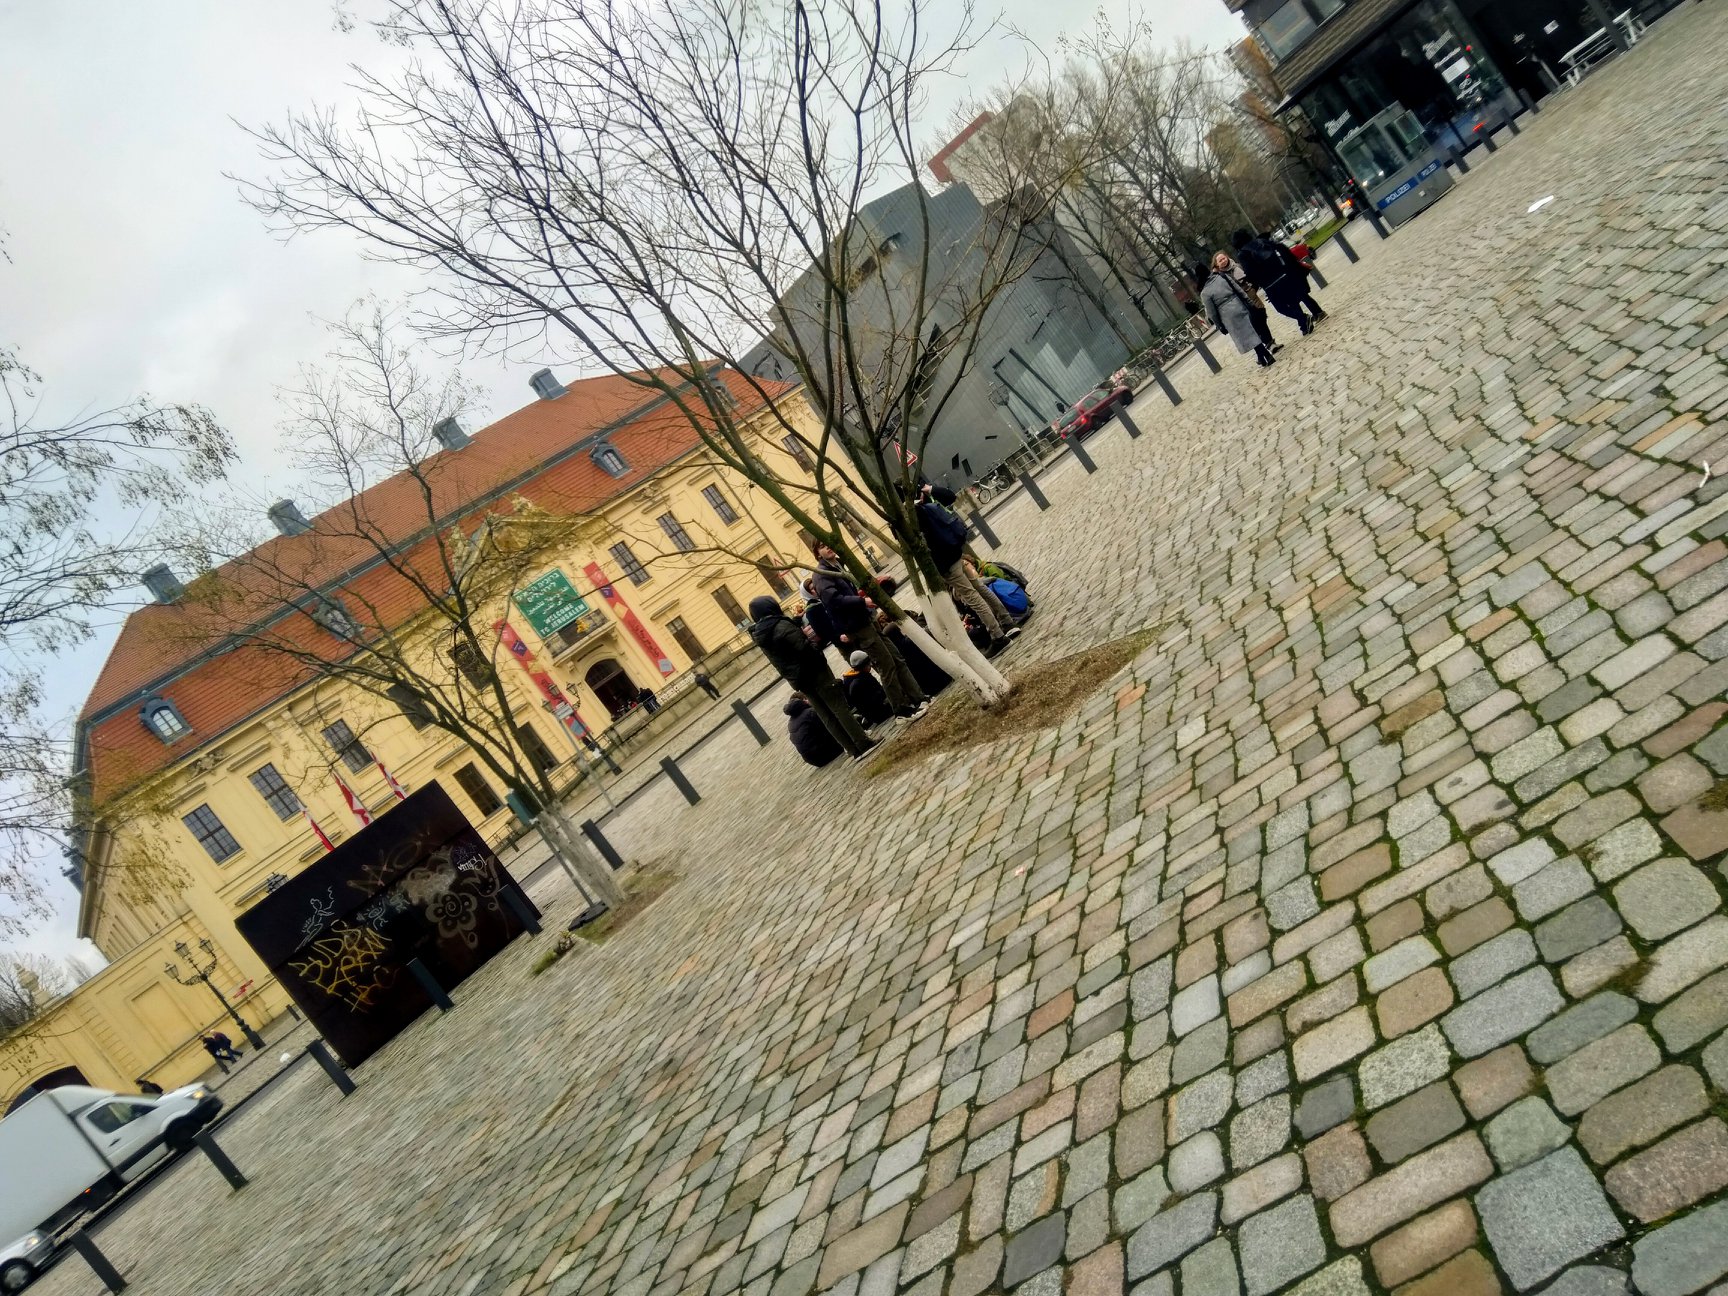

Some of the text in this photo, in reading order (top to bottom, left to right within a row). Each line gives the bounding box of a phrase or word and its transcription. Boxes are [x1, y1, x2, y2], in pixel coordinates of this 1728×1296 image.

[1385, 182, 1411, 204] POLIZEI
[540, 626, 550, 635] TO
[550, 603, 586, 628] JERUSALEM
[544, 603, 574, 624] WELCOME
